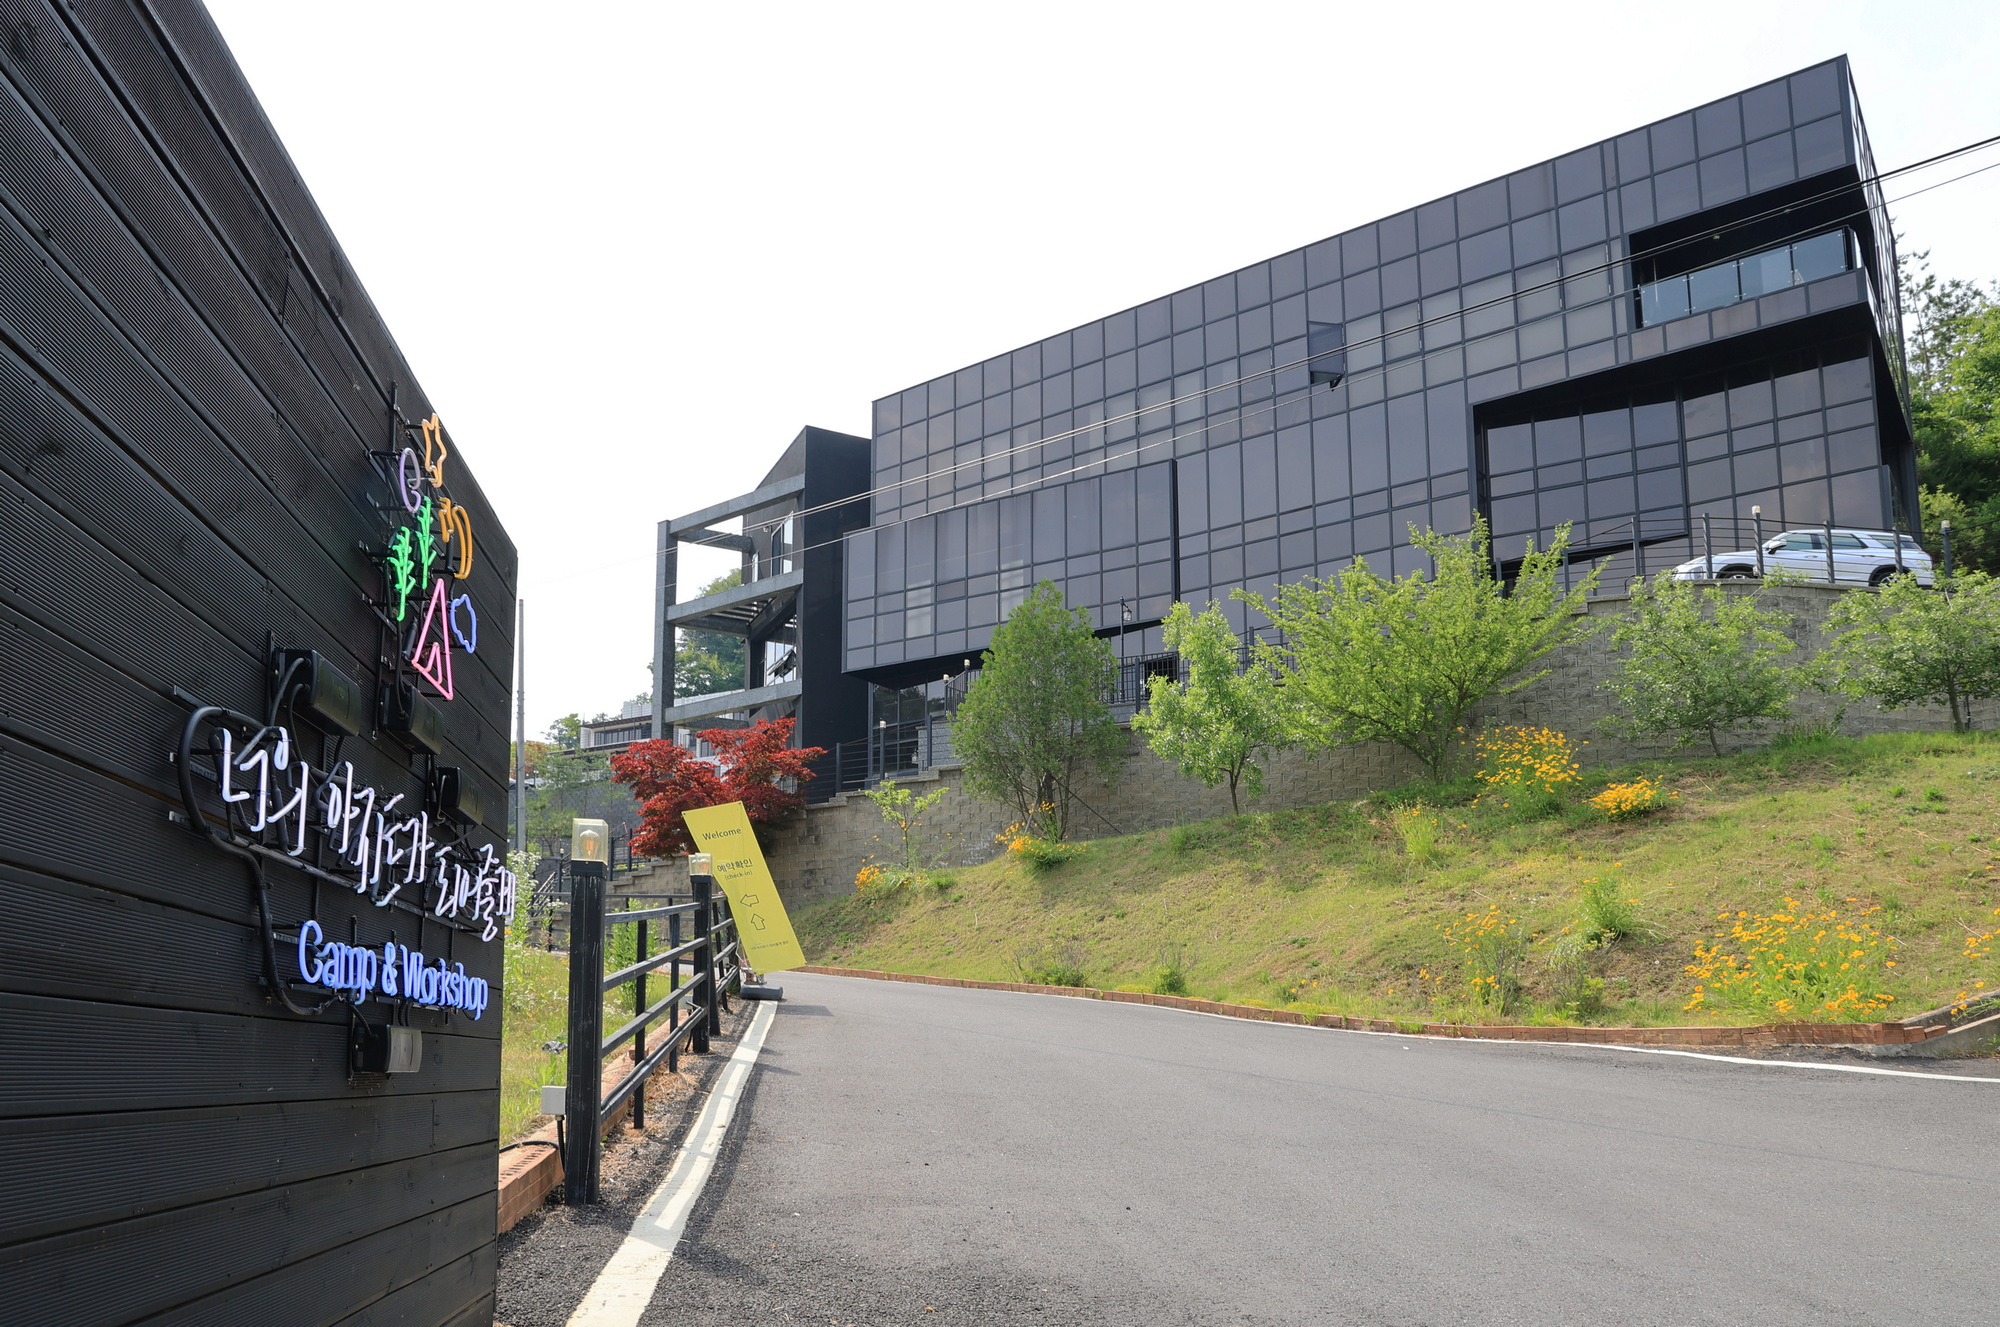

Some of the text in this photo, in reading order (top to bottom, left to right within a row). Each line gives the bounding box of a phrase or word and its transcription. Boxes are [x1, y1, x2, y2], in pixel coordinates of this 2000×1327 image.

[702, 828, 742, 840] Welcome
[716, 858, 753, 873] 예약확인
[724, 869, 753, 881] (check-in)
[299, 919, 489, 1021] Camp & Workshop
